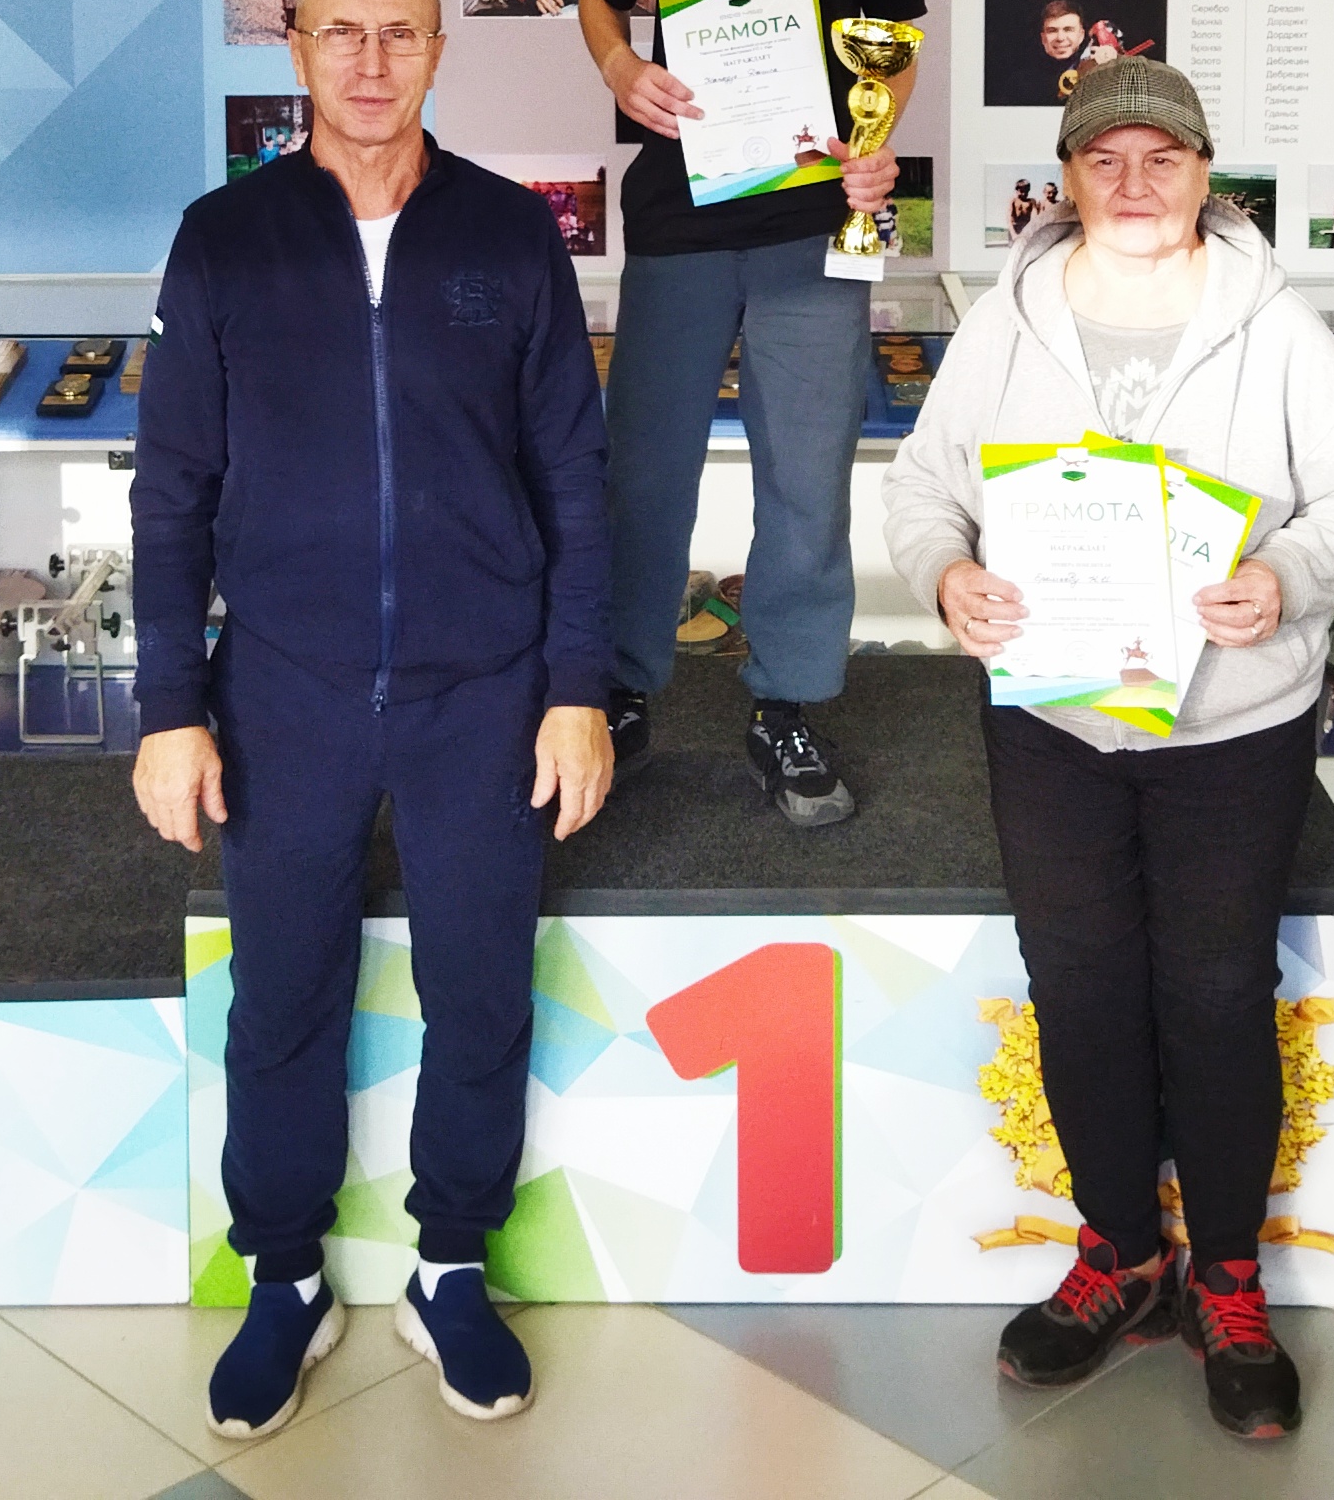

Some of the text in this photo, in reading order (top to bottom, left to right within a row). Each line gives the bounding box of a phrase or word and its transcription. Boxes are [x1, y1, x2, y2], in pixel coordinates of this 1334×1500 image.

[685, 14, 800, 48] ГРАМОТА
[1010, 502, 1143, 521] ГРАМОТА
[645, 941, 843, 1274] 1
